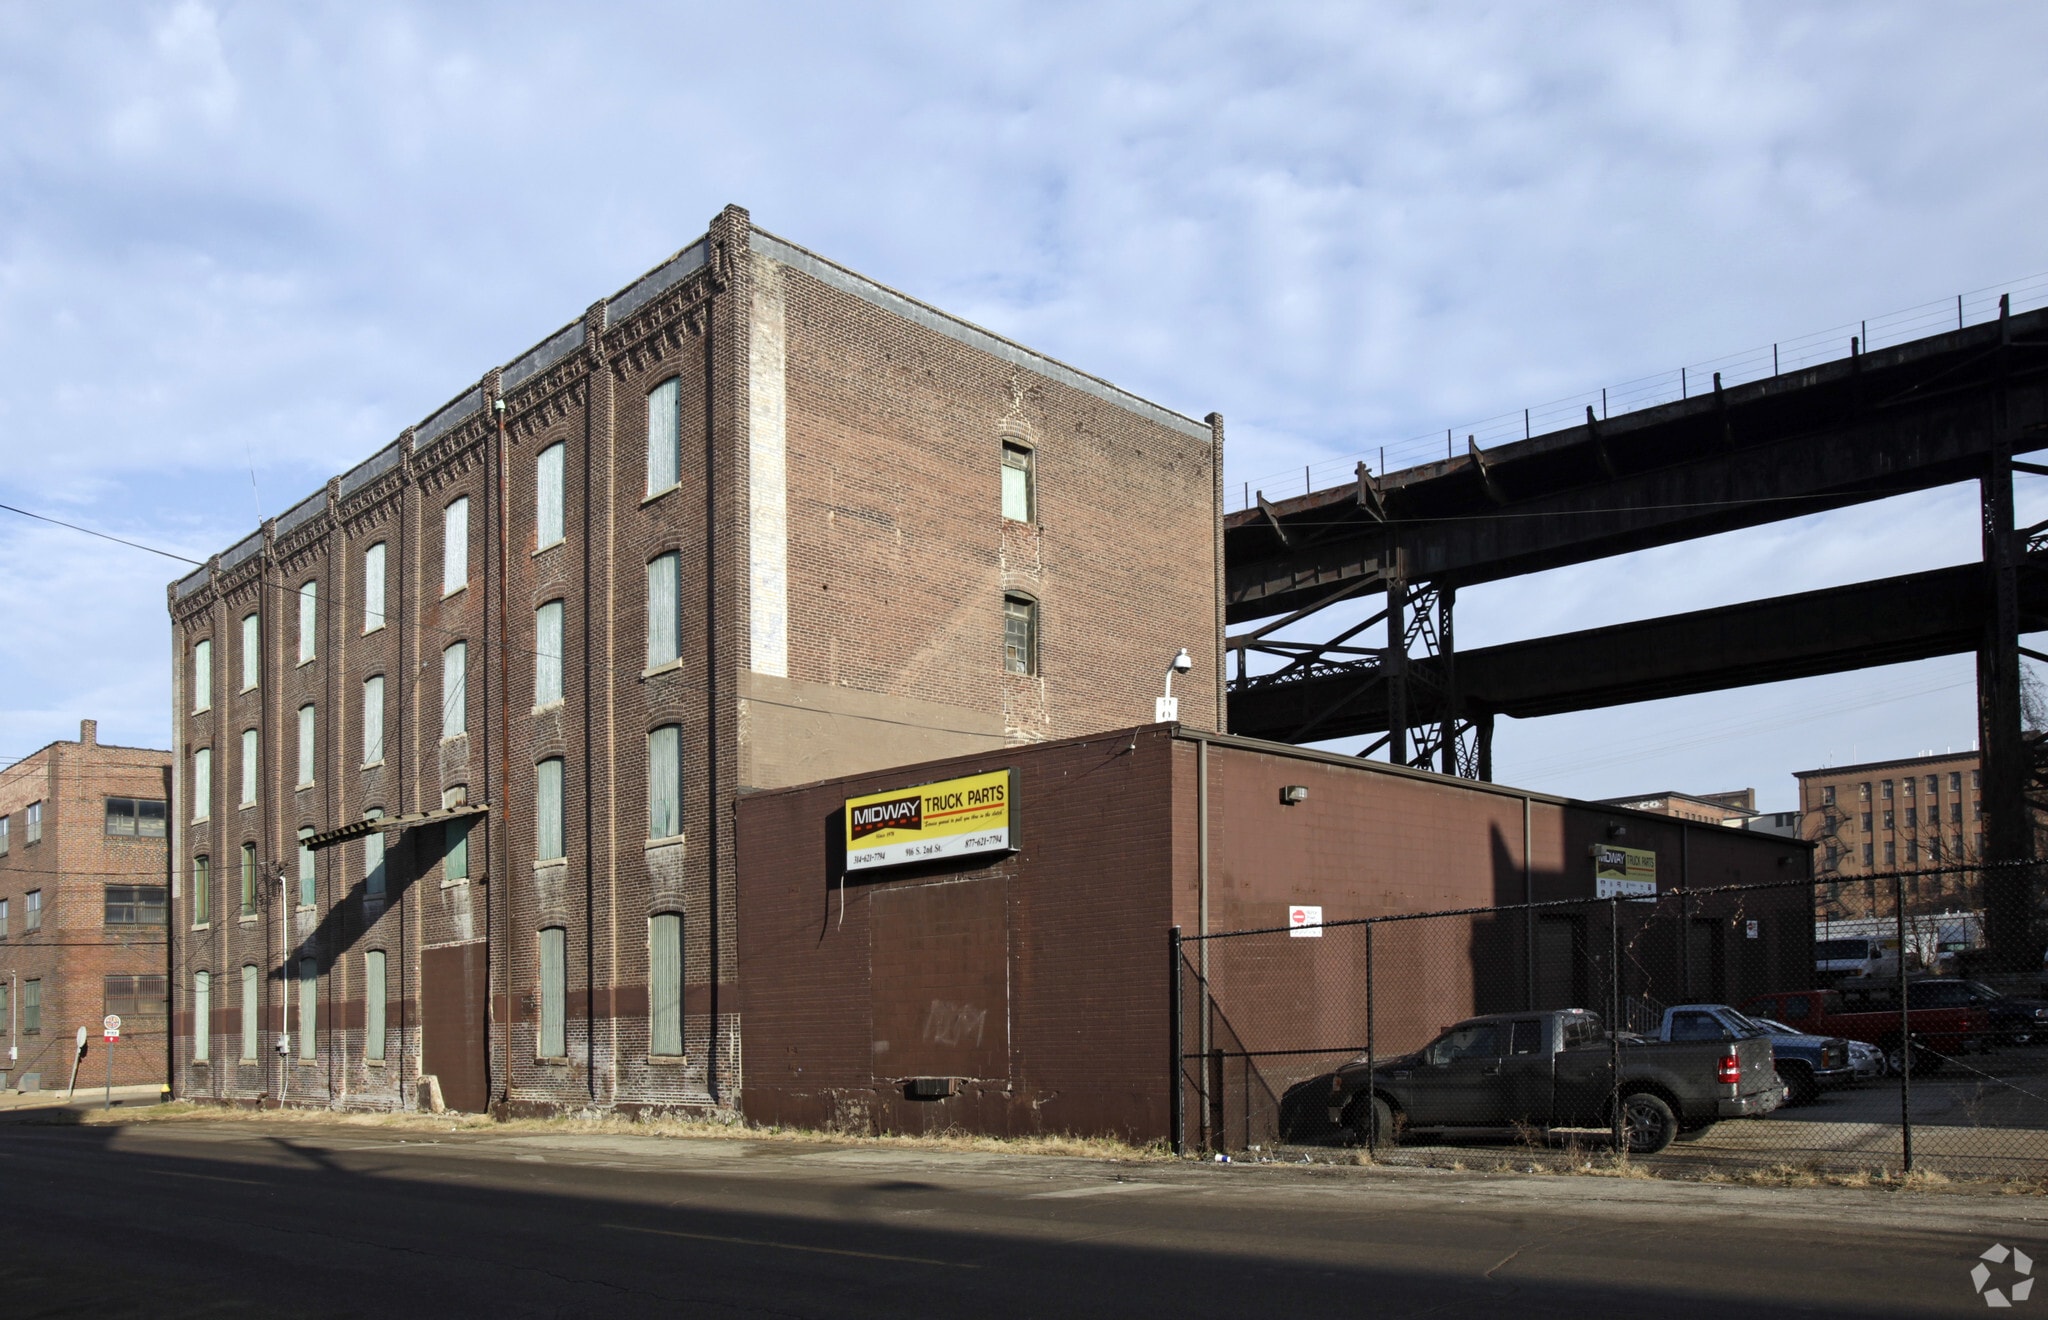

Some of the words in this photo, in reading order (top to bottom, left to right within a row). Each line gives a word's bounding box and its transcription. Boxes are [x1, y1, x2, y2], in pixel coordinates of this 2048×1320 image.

[925, 792, 963, 812] TRUCK
[968, 785, 1004, 805] PARTS
[854, 799, 920, 825] MIDWAY
[923, 844, 933, 854] 2nd
[965, 834, 1002, 848] 877-621-7794
